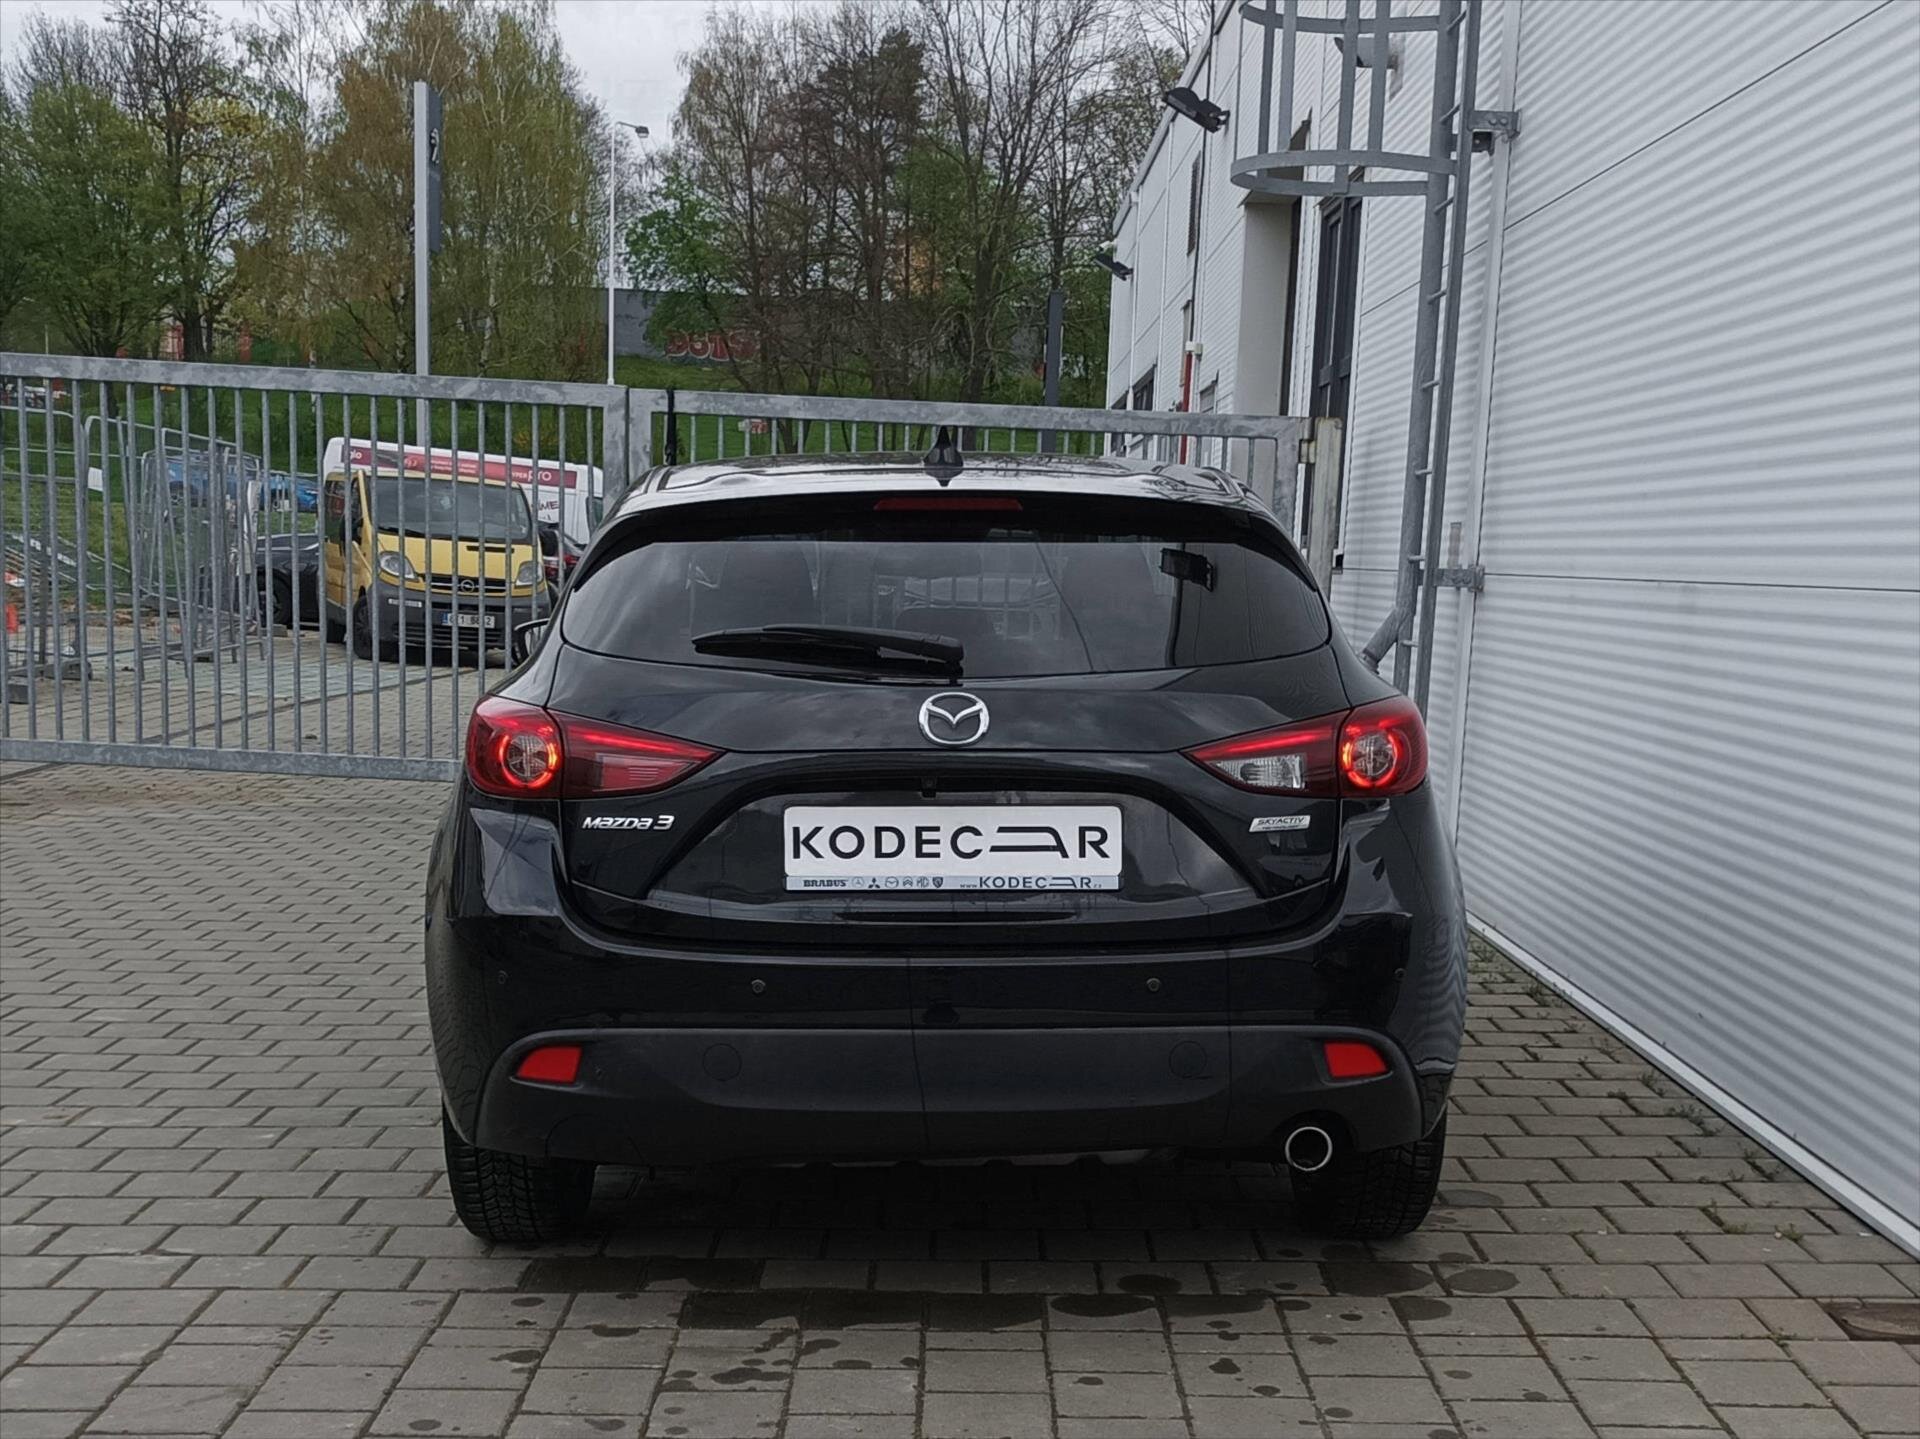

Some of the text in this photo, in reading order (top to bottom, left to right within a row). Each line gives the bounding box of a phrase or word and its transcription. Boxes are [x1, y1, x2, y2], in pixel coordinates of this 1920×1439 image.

[653, 815, 675, 830] 3
[1257, 817, 1304, 827] SKYACTIV
[792, 825, 1110, 859] KODECAR
[803, 879, 847, 888] BRABUS
